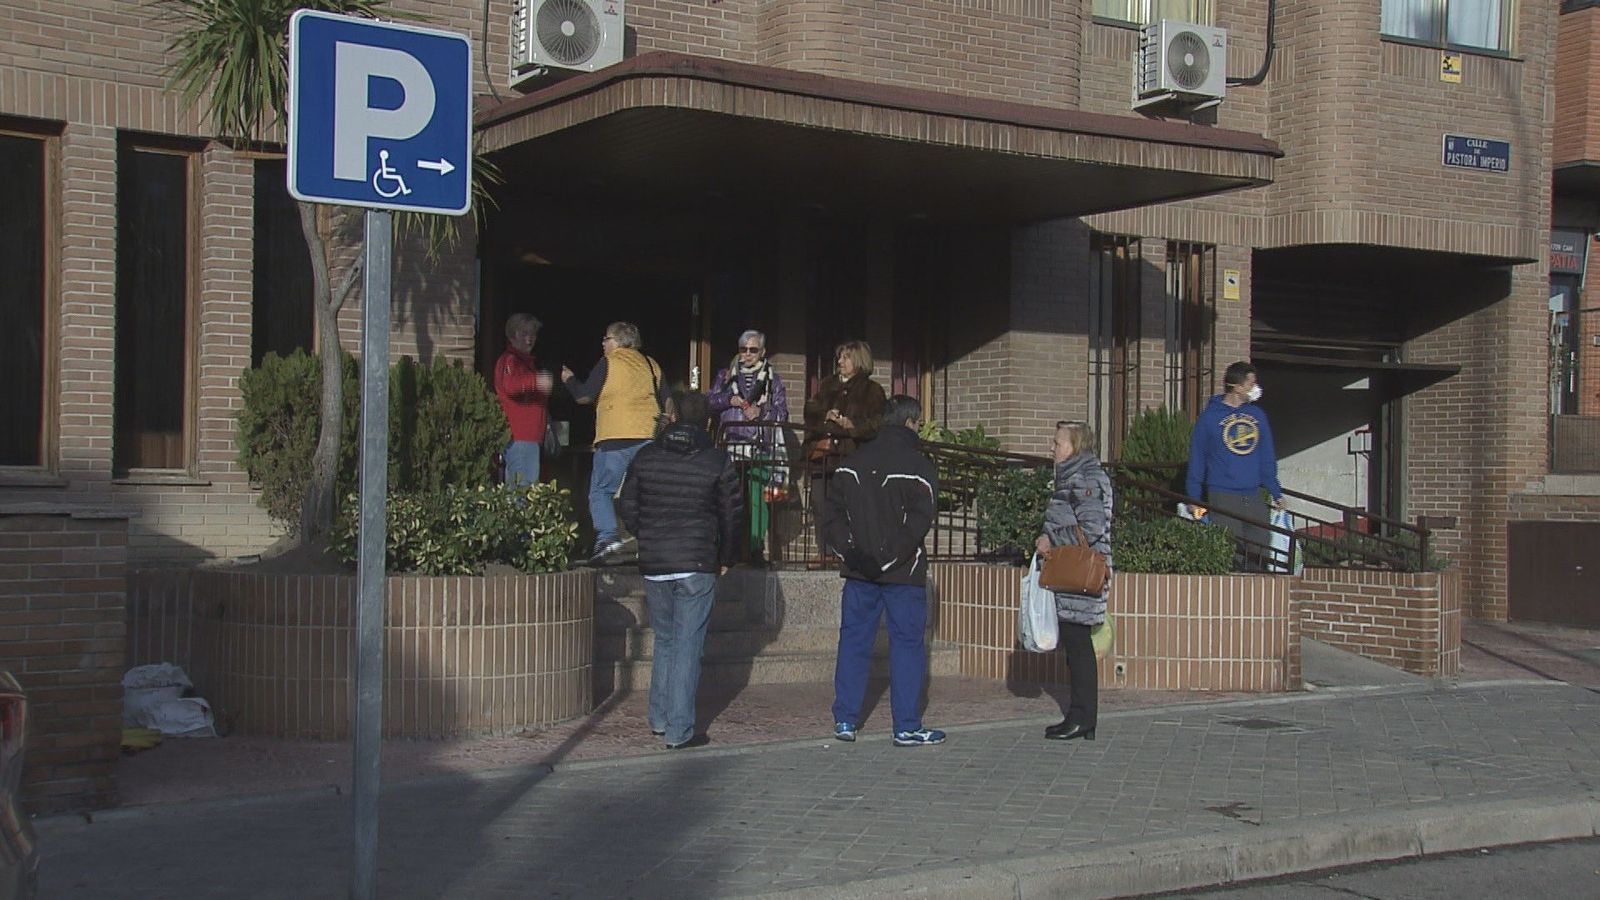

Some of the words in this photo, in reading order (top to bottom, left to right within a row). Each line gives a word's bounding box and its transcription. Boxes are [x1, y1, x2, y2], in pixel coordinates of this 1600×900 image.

[334, 41, 436, 182] P
[1466, 139, 1488, 148] CALLE
[1446, 152, 1477, 166] PASTORA
[1480, 156, 1506, 169] IMPERIO
